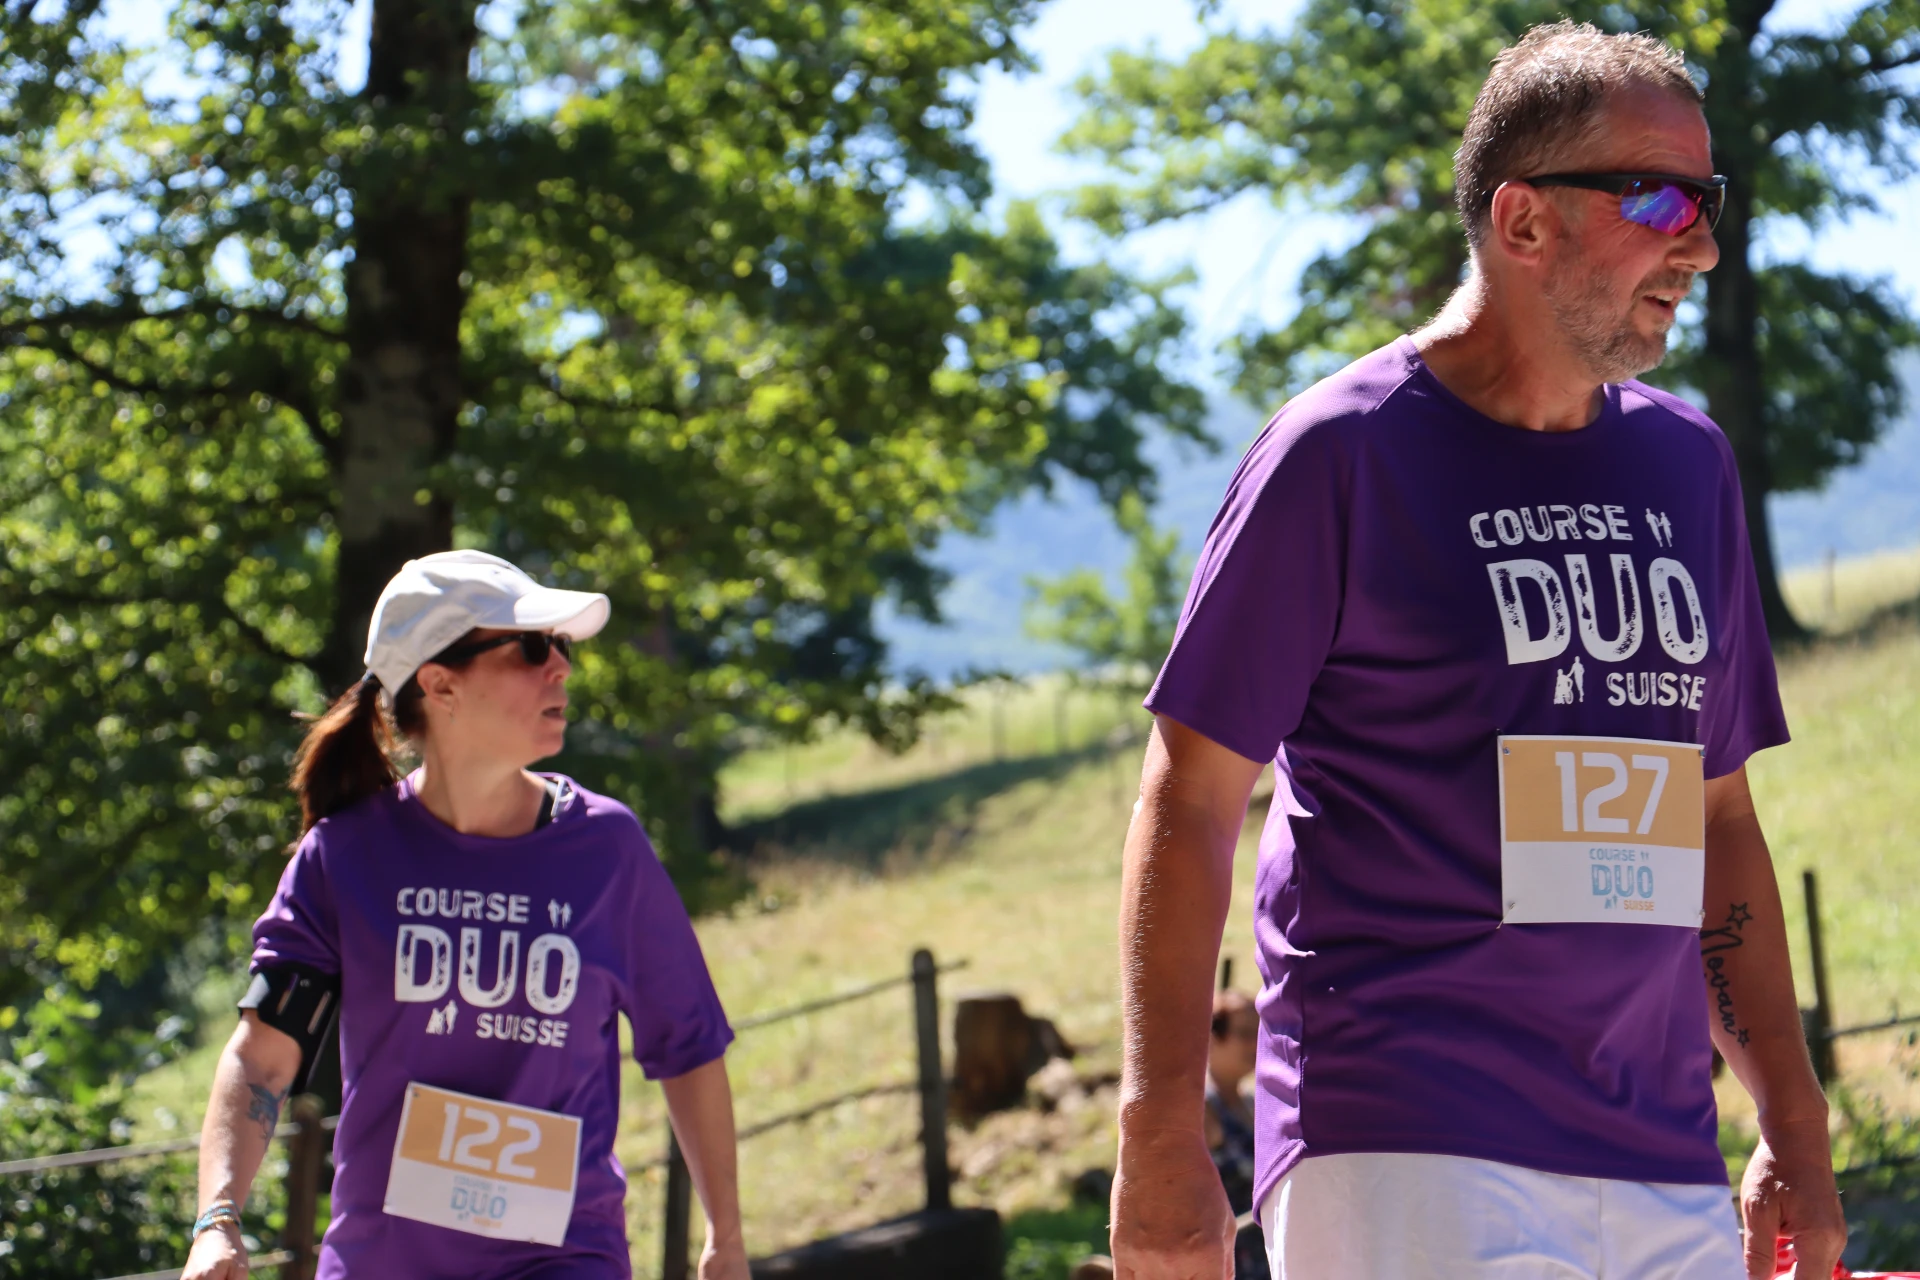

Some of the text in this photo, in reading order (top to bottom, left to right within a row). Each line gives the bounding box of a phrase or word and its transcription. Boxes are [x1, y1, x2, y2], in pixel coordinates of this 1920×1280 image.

[1469, 504, 1634, 548] COURSE
[1486, 553, 1709, 665] DUO
[1606, 671, 1706, 712] SUISSE
[1555, 752, 1669, 835] 127
[1589, 848, 1636, 862] COURSE
[1591, 864, 1654, 899] DUO
[396, 887, 531, 924] COURSE
[1623, 899, 1655, 911] SUISSE
[394, 923, 581, 1015] DUO
[475, 1012, 570, 1048] SUISSE
[437, 1101, 542, 1180] 122
[449, 1186, 508, 1219] DUO
